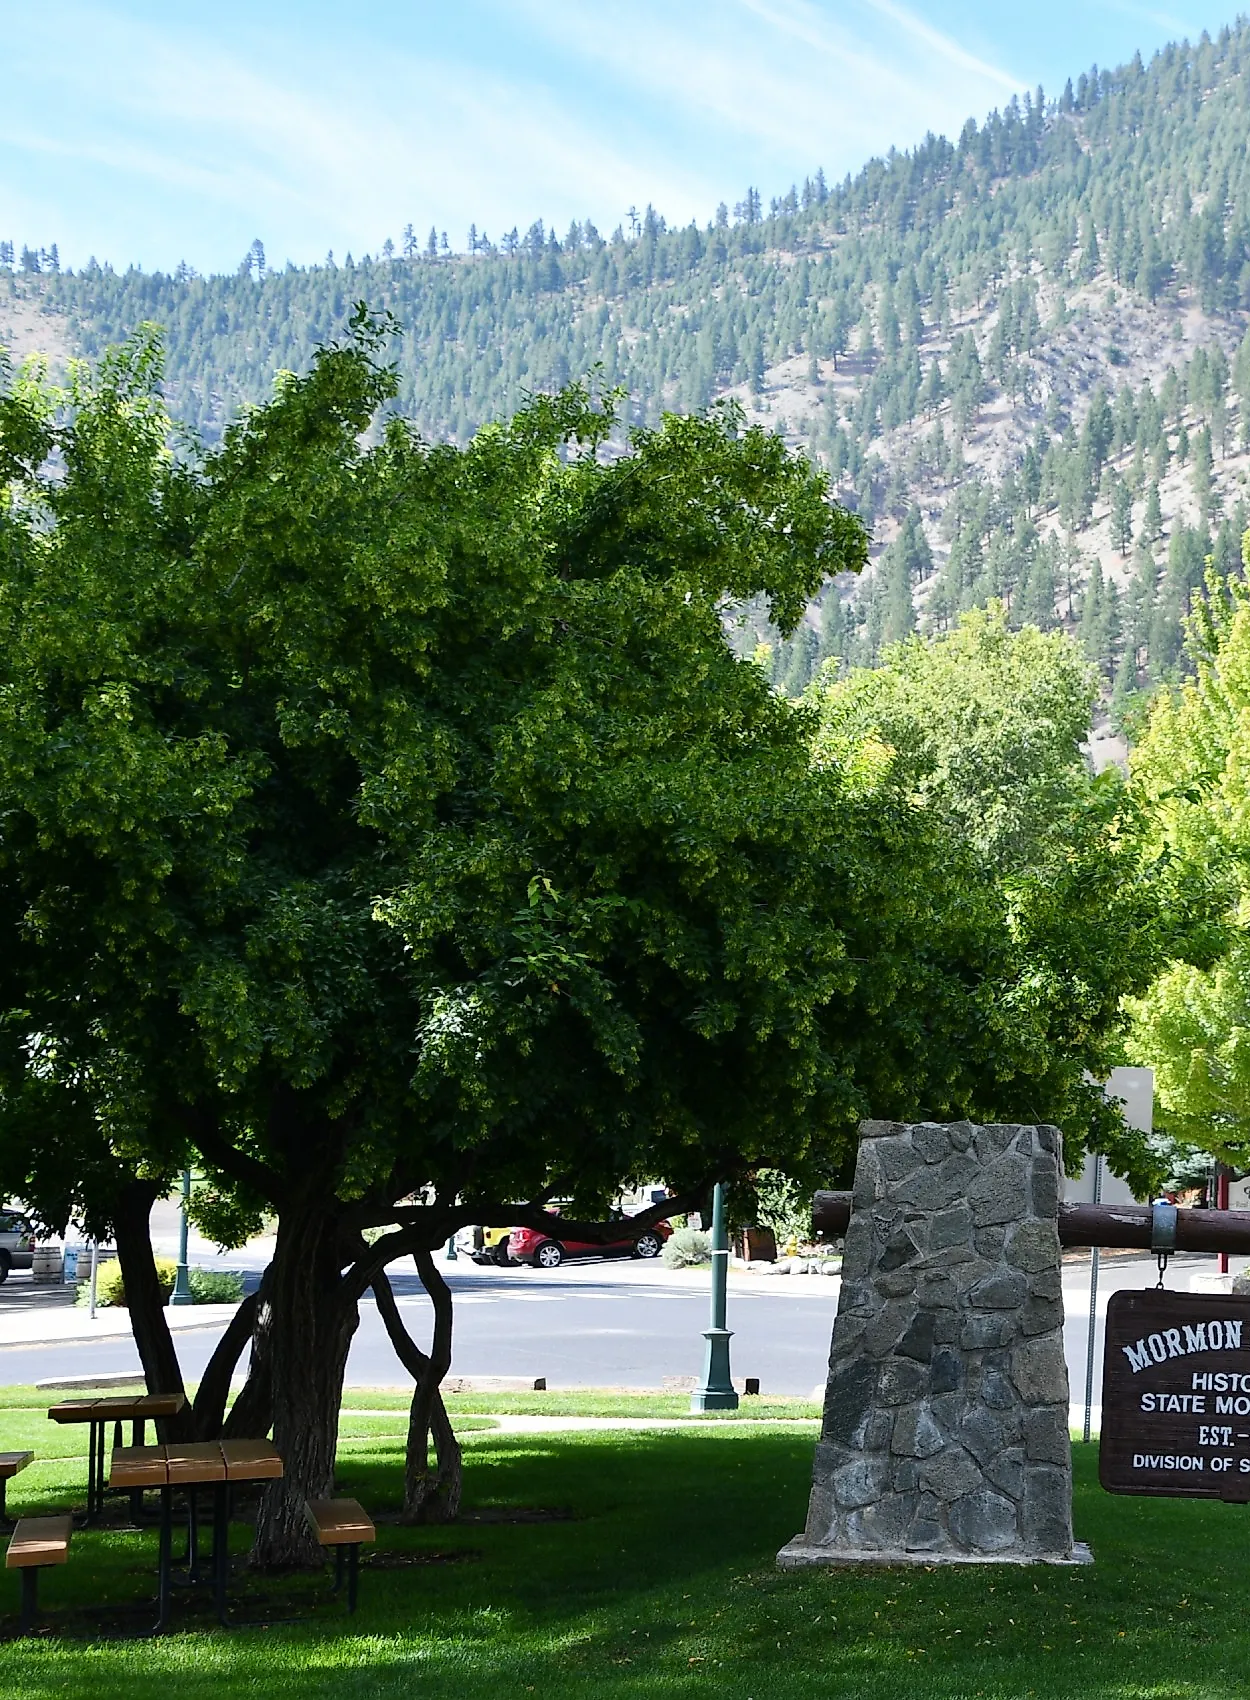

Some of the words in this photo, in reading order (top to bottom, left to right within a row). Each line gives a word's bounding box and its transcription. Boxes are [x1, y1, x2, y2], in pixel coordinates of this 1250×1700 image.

[1122, 1320, 1243, 1374] MORMON
[1140, 1393, 1206, 1414] STATE
[1132, 1454, 1204, 1471] DIVISION
[1210, 1457, 1233, 1472] OF
